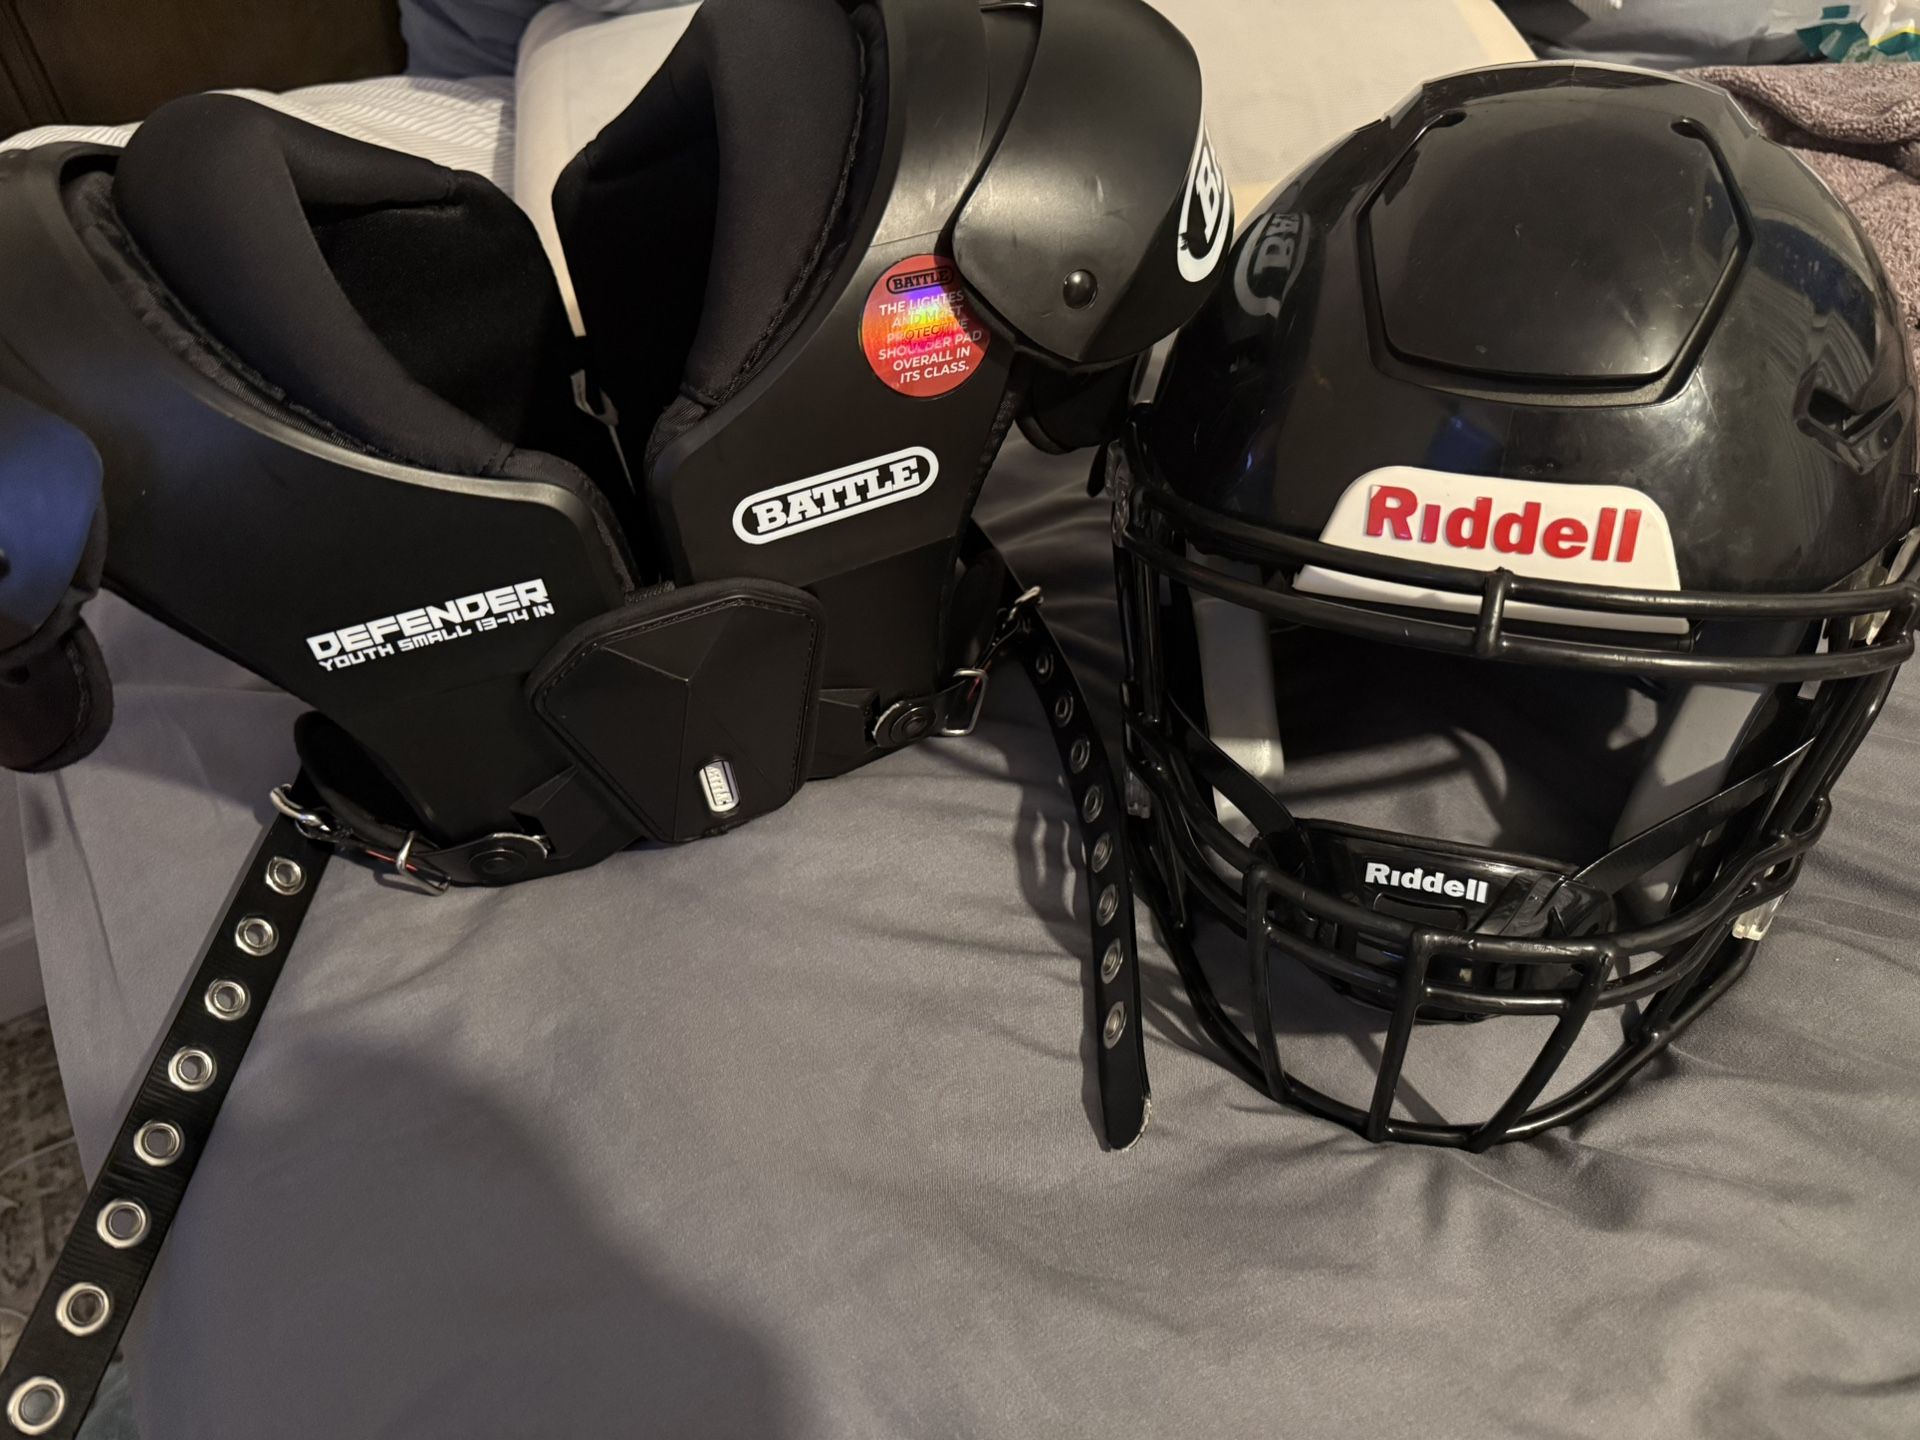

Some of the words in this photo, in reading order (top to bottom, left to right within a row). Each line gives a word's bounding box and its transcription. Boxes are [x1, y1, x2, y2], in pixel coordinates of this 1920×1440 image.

[892, 270, 949, 290] BATTLE
[879, 301, 906, 316] THE
[892, 313, 921, 328] AND
[878, 336, 951, 360] SHOULDER
[954, 330, 983, 345] PAD
[893, 350, 953, 372] OVERALL
[956, 346, 970, 359] IN
[900, 370, 920, 384] ITS
[924, 361, 969, 378] CLASS.
[751, 457, 921, 534] BATTLE
[1366, 484, 1642, 563] Riddell
[306, 578, 551, 661] DEFENDER
[319, 643, 395, 671] YOUTH
[397, 625, 472, 652] SMALL
[475, 608, 530, 632] 13-14
[532, 602, 555, 618] IN
[1365, 862, 1489, 904] Riddell
